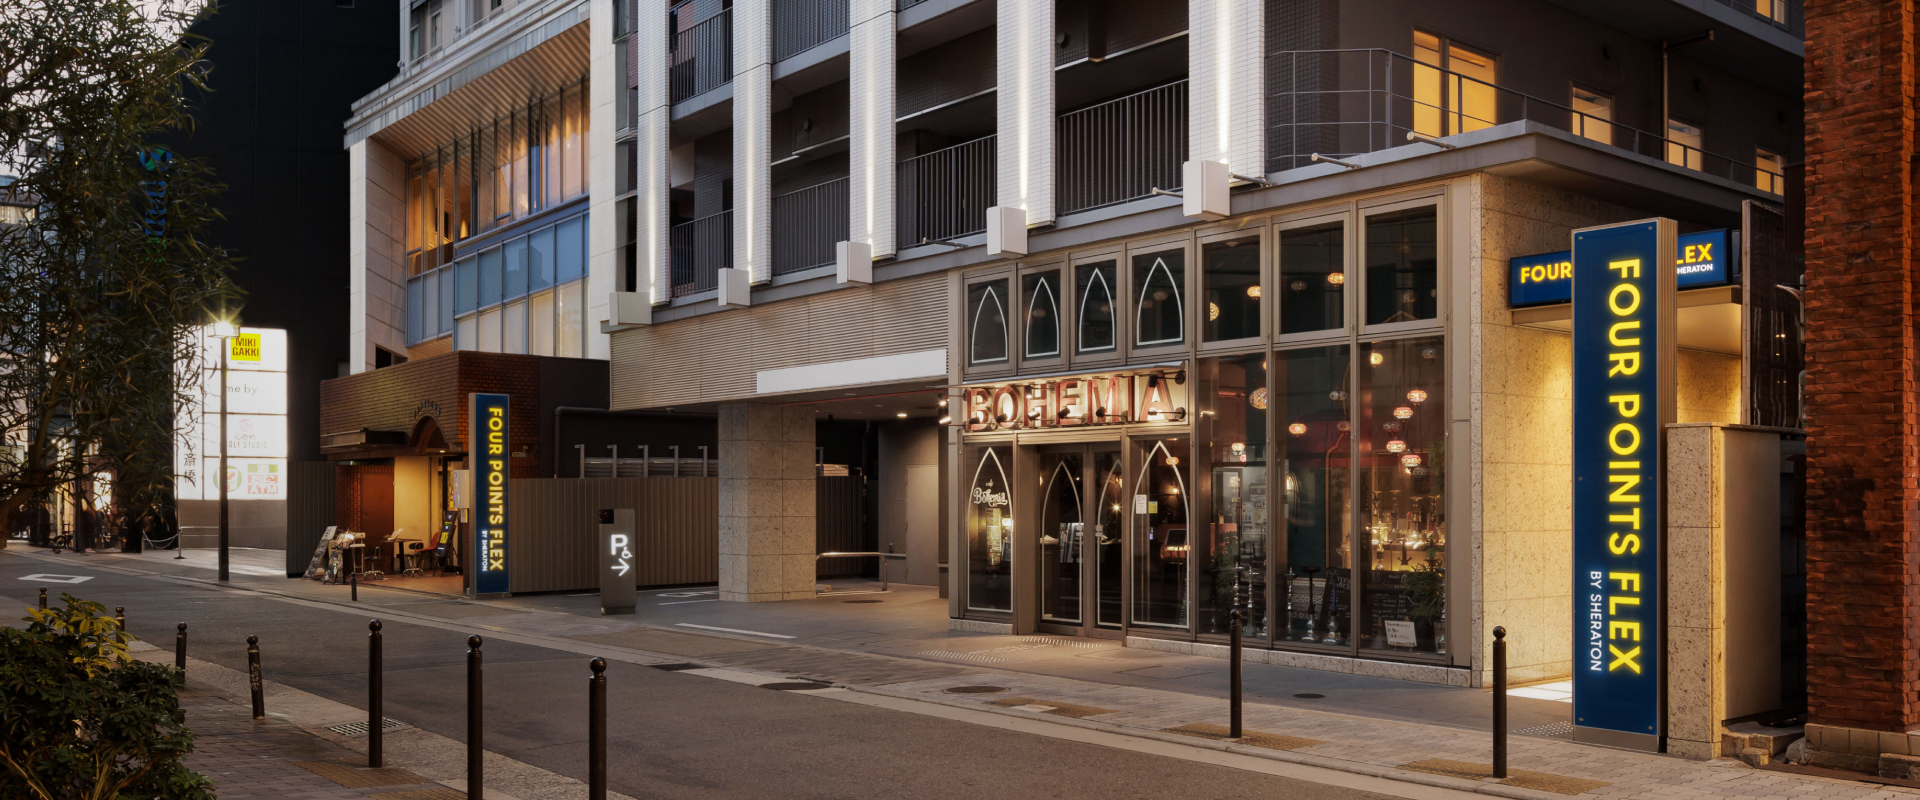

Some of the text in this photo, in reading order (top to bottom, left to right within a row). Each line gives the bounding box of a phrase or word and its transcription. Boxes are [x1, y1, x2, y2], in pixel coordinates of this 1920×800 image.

[1677, 243, 1713, 265] EX
[1520, 261, 1572, 284] FOUR
[1677, 263, 1714, 274] HERATON
[232, 347, 260, 356] GAKKI
[235, 337, 256, 347] MIKI
[244, 384, 258, 396] by
[966, 371, 1176, 431] BOHEMIA
[228, 440, 268, 449] OLF STUDIO
[1608, 258, 1641, 674] FOUR POINTS FLEX
[249, 485, 277, 494] ATM
[488, 407, 503, 571] FOUR POINTS FLEX
[973, 487, 1009, 507] Bohemia
[611, 534, 628, 555] P
[1590, 571, 1602, 671] BY SHERATON
